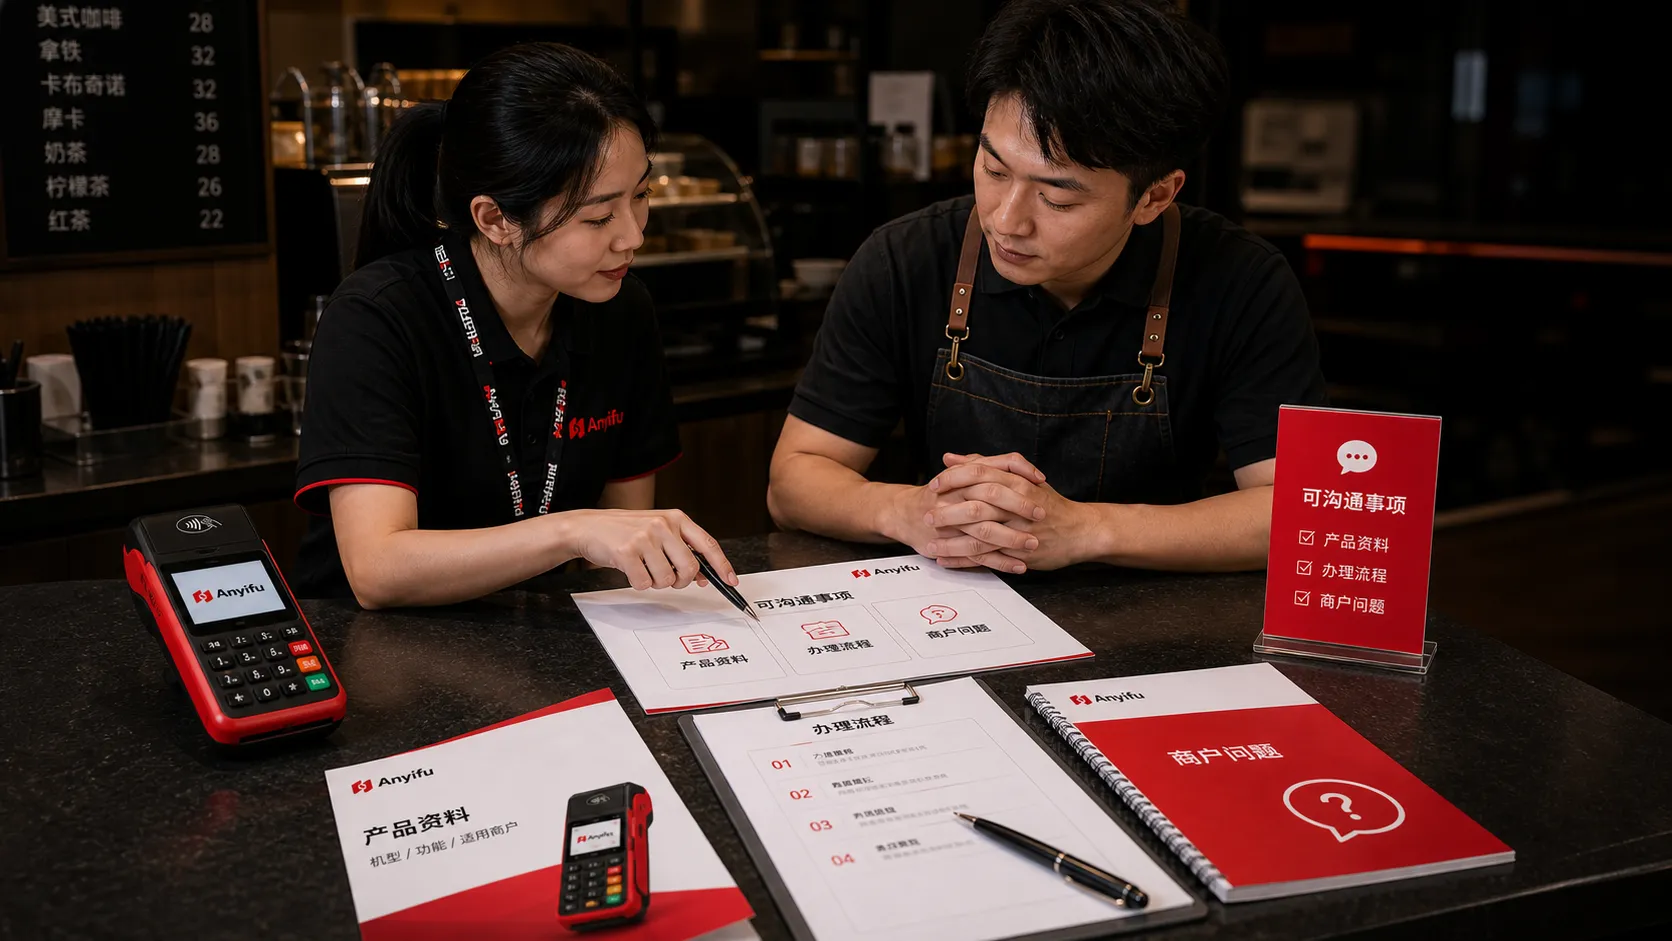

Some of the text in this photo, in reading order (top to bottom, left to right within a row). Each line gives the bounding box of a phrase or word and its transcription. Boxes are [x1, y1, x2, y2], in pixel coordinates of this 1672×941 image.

[37, 4, 214, 33] 美式咖啡 28
[39, 38, 215, 66] 拿铁 32
[40, 72, 217, 100] 卡布奇诺 32
[42, 106, 220, 132] 摩卡 36
[44, 141, 221, 165] 奶茶 28
[46, 174, 223, 199] 柠檬茶 26
[48, 208, 224, 232] 红茶 22
[1303, 488, 1406, 515] 可沟通事项
[1324, 533, 1389, 553] 产品资料
[874, 563, 921, 576] Anyifu
[1323, 563, 1386, 583] 办理流程
[217, 584, 264, 598] Anyifu
[754, 590, 854, 609] 可沟通事项
[1321, 594, 1384, 614] 商户问题
[925, 623, 991, 640] 商户问题
[807, 638, 874, 655] 办理流程
[680, 654, 748, 671] 产品资料
[1094, 690, 1146, 704] Anyifu
[812, 715, 894, 735] 办理流程
[772, 760, 791, 769] 01
[1167, 744, 1283, 766] 商户问题
[379, 769, 433, 787] Anyifu
[790, 789, 812, 800] 02
[363, 806, 470, 846] 产品资料
[809, 820, 832, 832] 03
[370, 850, 402, 868] 机型
[416, 840, 448, 856] 功能
[460, 821, 518, 845] 适用商户
[831, 853, 855, 866] 04
